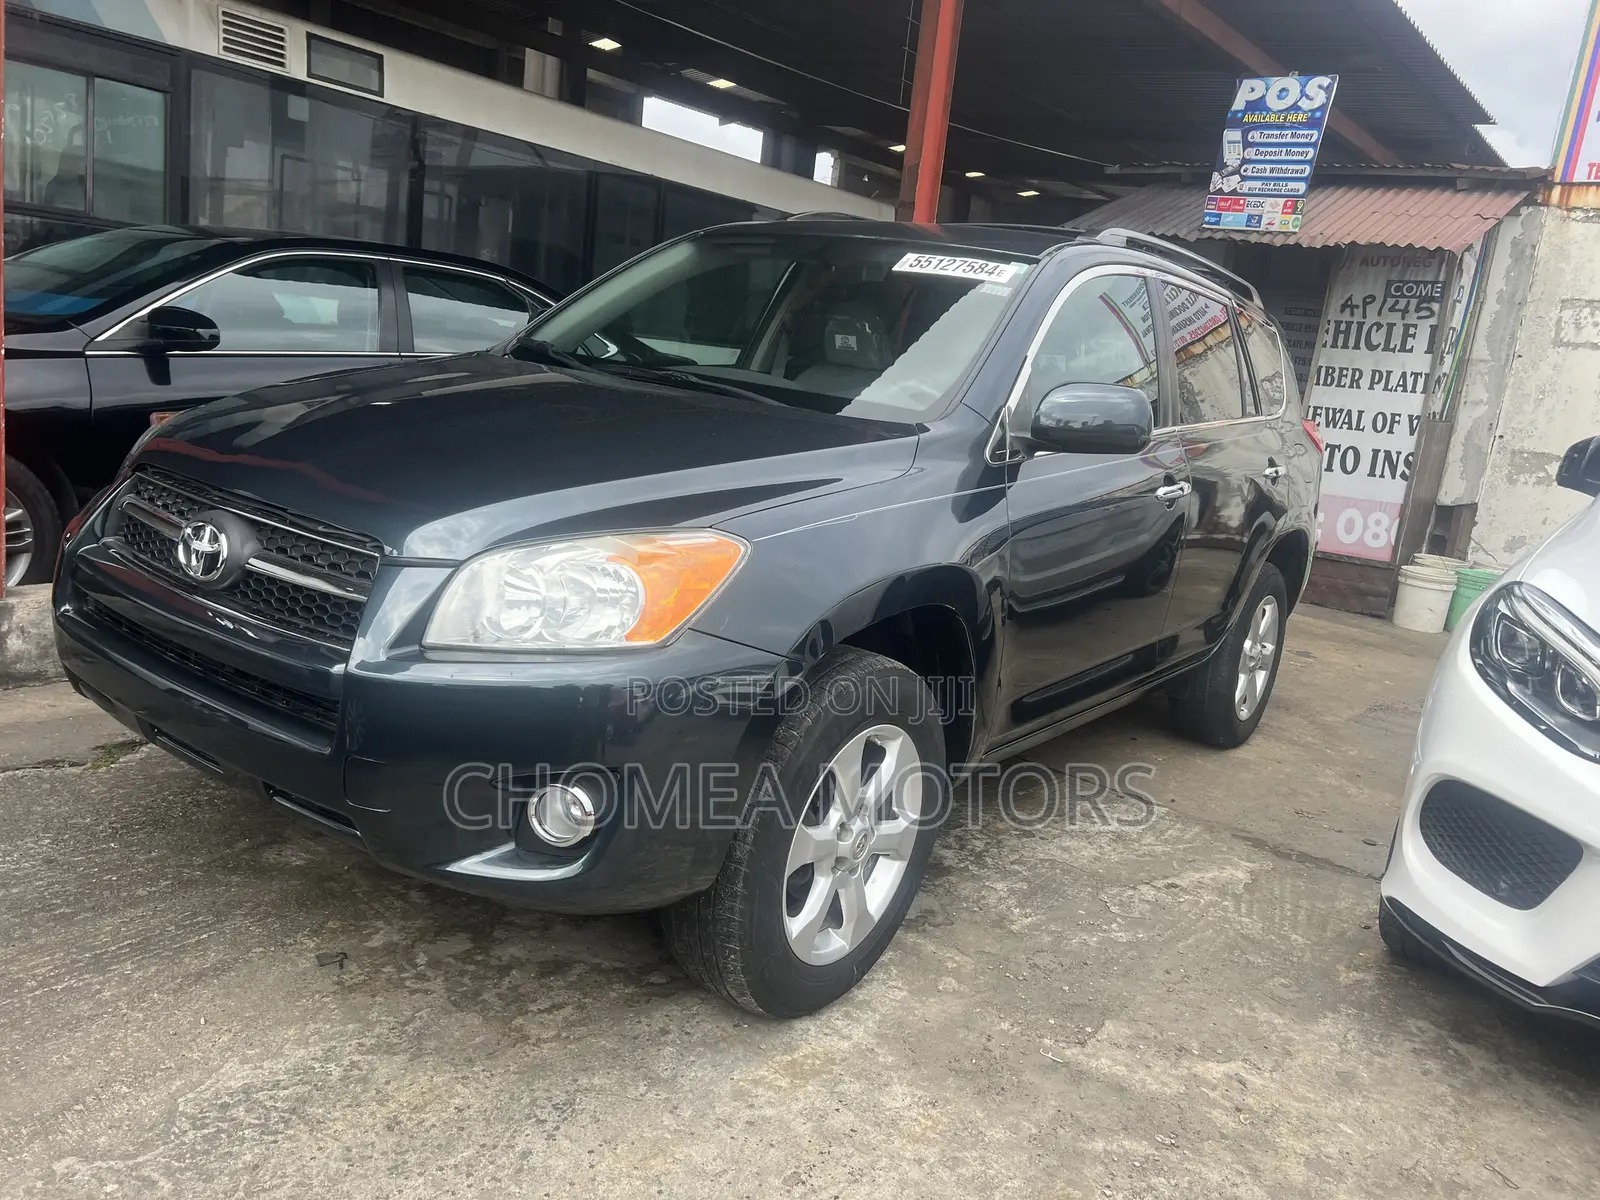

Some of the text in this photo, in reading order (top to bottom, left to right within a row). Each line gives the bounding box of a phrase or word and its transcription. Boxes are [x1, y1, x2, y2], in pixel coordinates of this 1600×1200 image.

[1231, 76, 1333, 111] POS
[1242, 113, 1309, 123] AVAILABLE HERE
[1259, 131, 1315, 141] Transfer Money
[1254, 148, 1310, 158] Deposit Money
[1251, 166, 1306, 175] Cash Withdrawal
[1390, 282, 1442, 297] COME
[1371, 411, 1402, 434] OF
